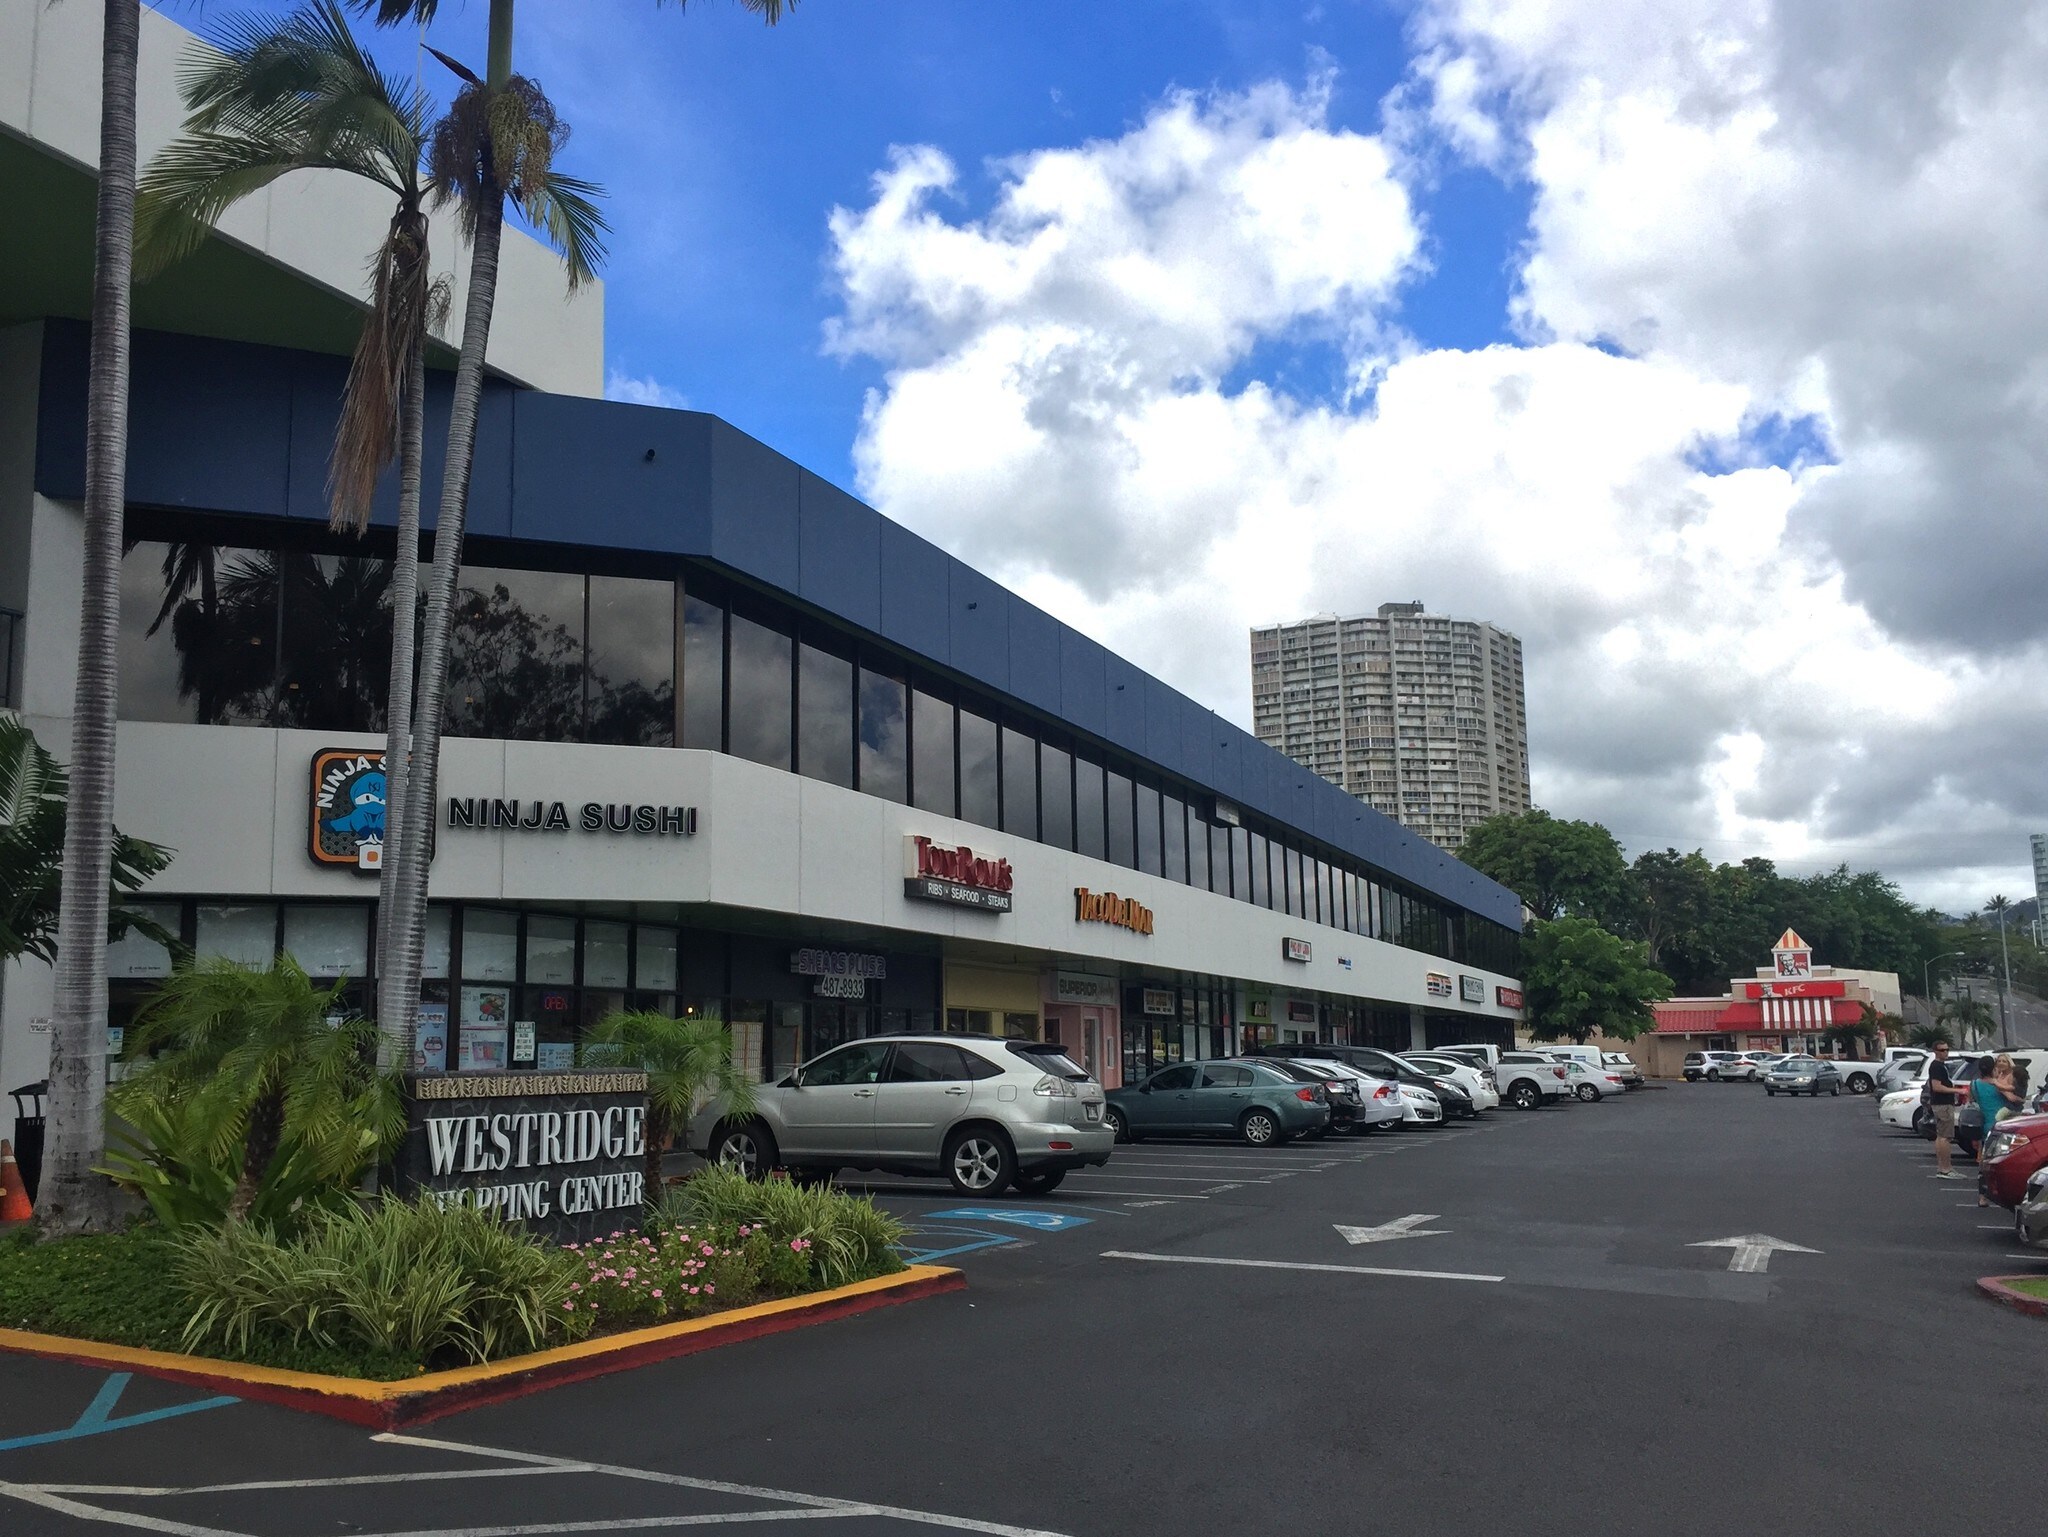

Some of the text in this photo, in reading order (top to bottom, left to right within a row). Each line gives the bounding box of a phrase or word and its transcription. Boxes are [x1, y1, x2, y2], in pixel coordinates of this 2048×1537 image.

[317, 756, 372, 808] NINJA
[448, 797, 698, 834] NINJA SUSHI
[928, 882, 1009, 909] RIBS SEAFOOD STEAKS
[821, 975, 865, 999] 487-8933
[1059, 979, 1098, 997] SUPERIOR
[1784, 984, 1806, 996] KFC
[424, 1106, 645, 1176] WESTRIDGE
[558, 1171, 644, 1216] CENTER
